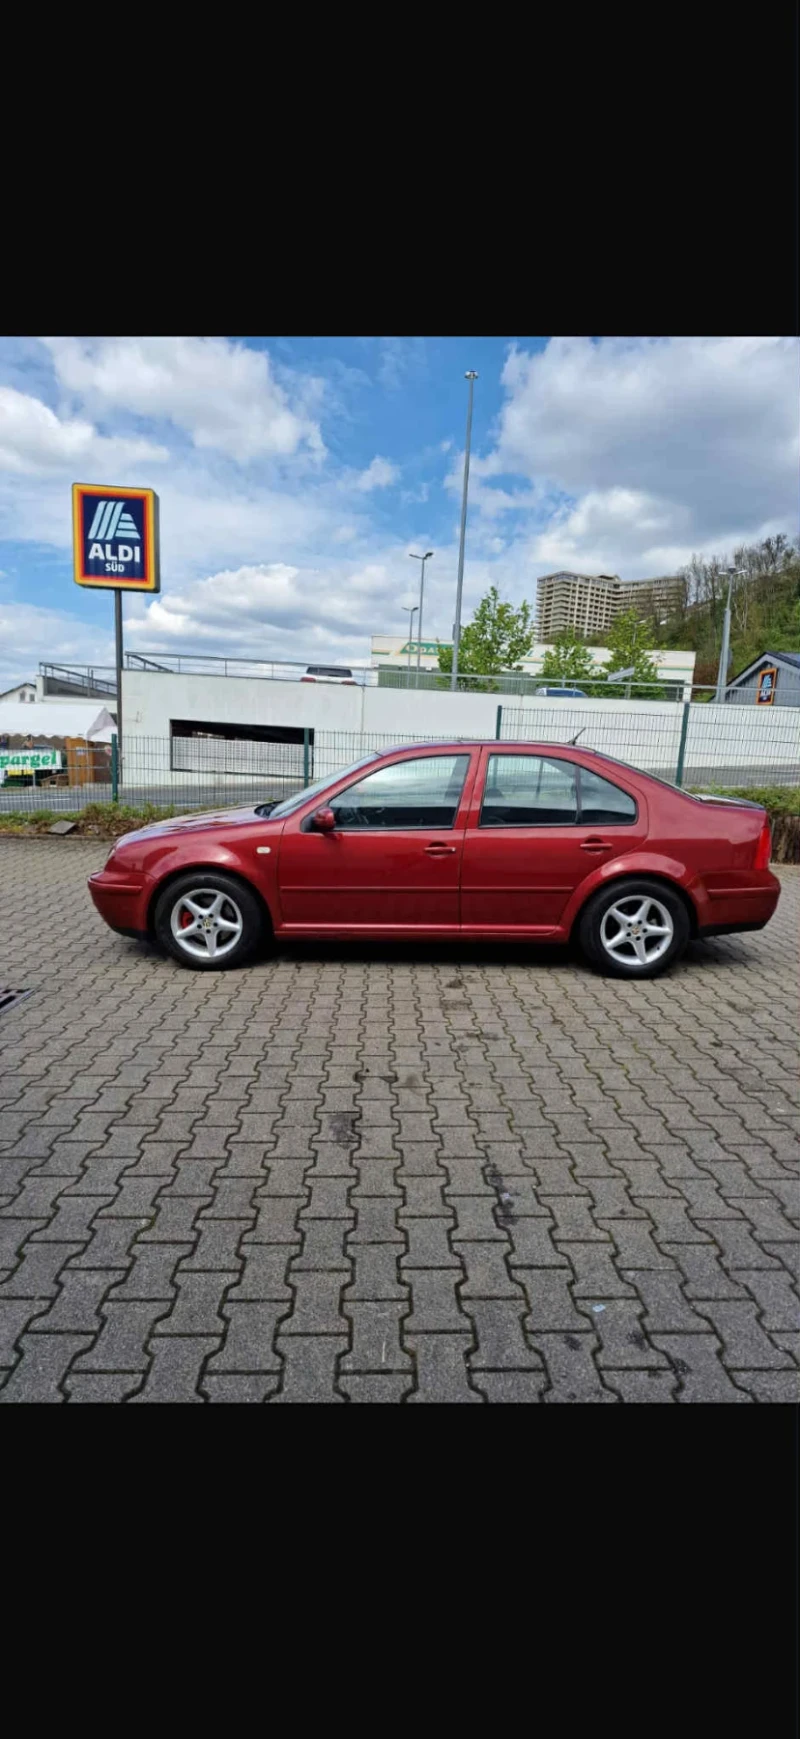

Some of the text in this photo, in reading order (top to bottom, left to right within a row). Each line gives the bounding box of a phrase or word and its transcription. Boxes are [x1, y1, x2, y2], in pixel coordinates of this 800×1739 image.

[88, 543, 140, 563] ALDI
[105, 561, 125, 573] SÜD
[0, 749, 57, 768] pargel
